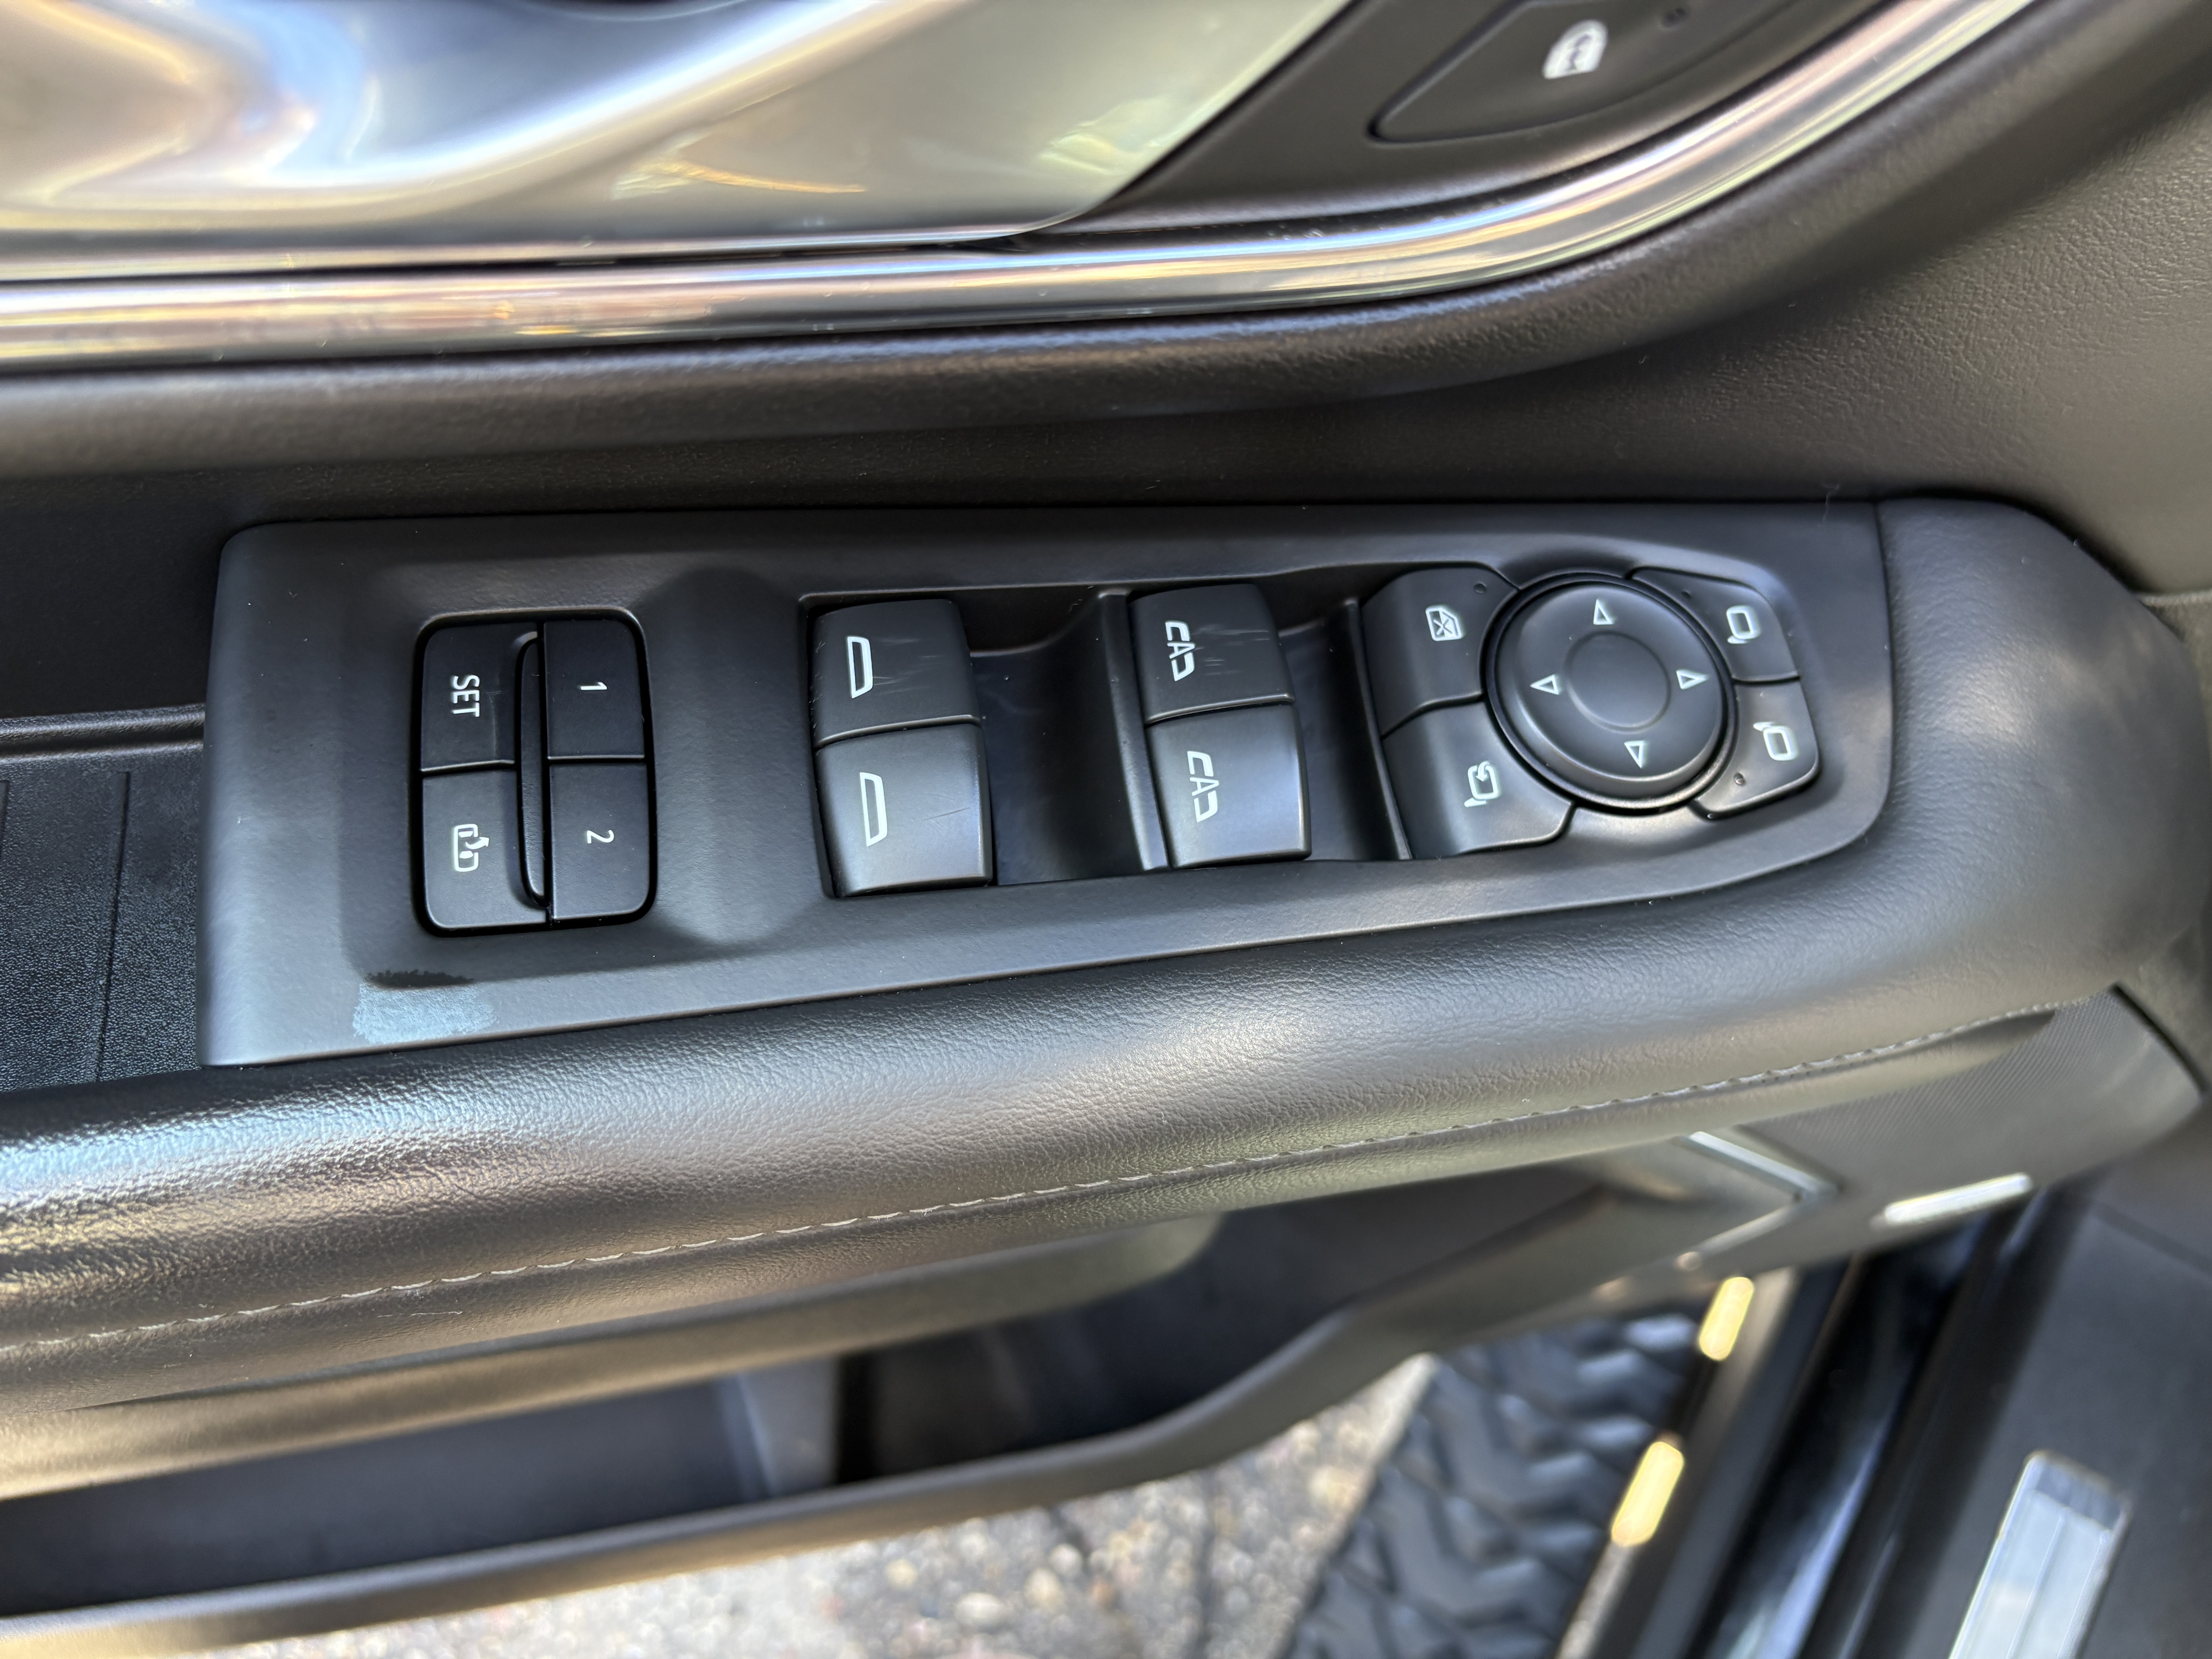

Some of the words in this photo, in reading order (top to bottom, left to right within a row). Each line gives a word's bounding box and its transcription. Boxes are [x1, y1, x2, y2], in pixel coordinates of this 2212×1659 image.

[580, 682, 607, 690] 1
[451, 675, 480, 717] SET
[586, 830, 614, 844] 2
